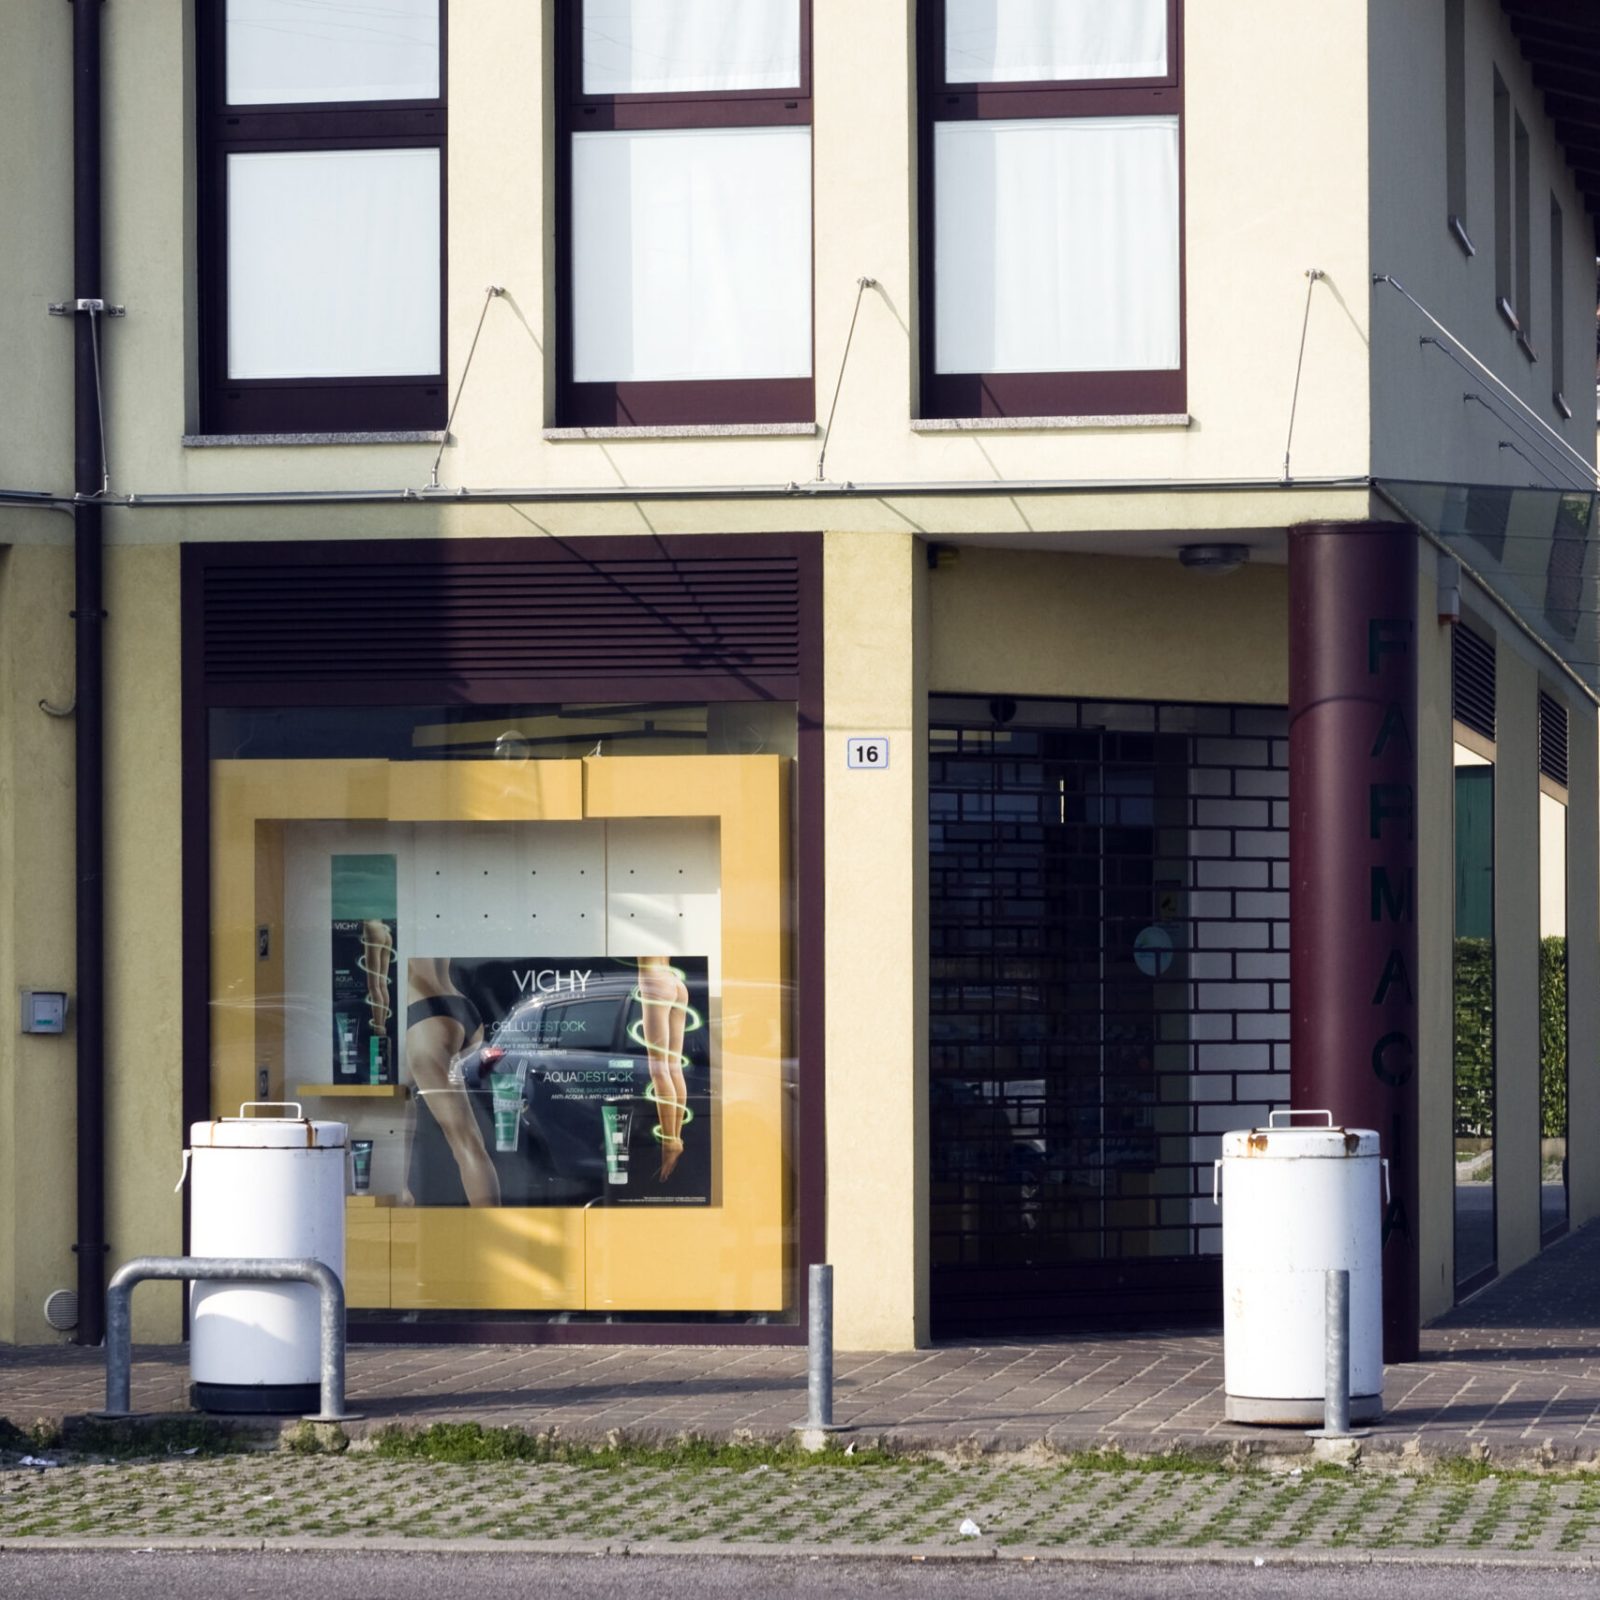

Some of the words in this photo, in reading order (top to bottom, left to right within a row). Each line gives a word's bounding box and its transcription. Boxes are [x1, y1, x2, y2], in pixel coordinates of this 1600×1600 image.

[856, 745, 879, 763] 16
[334, 922, 359, 930] VICHY
[1368, 618, 1413, 1252] FARMACIA
[512, 969, 592, 993] VICHY
[491, 1020, 586, 1033] CELLUDESTOCK
[543, 1071, 634, 1083] AQUADESTOCK
